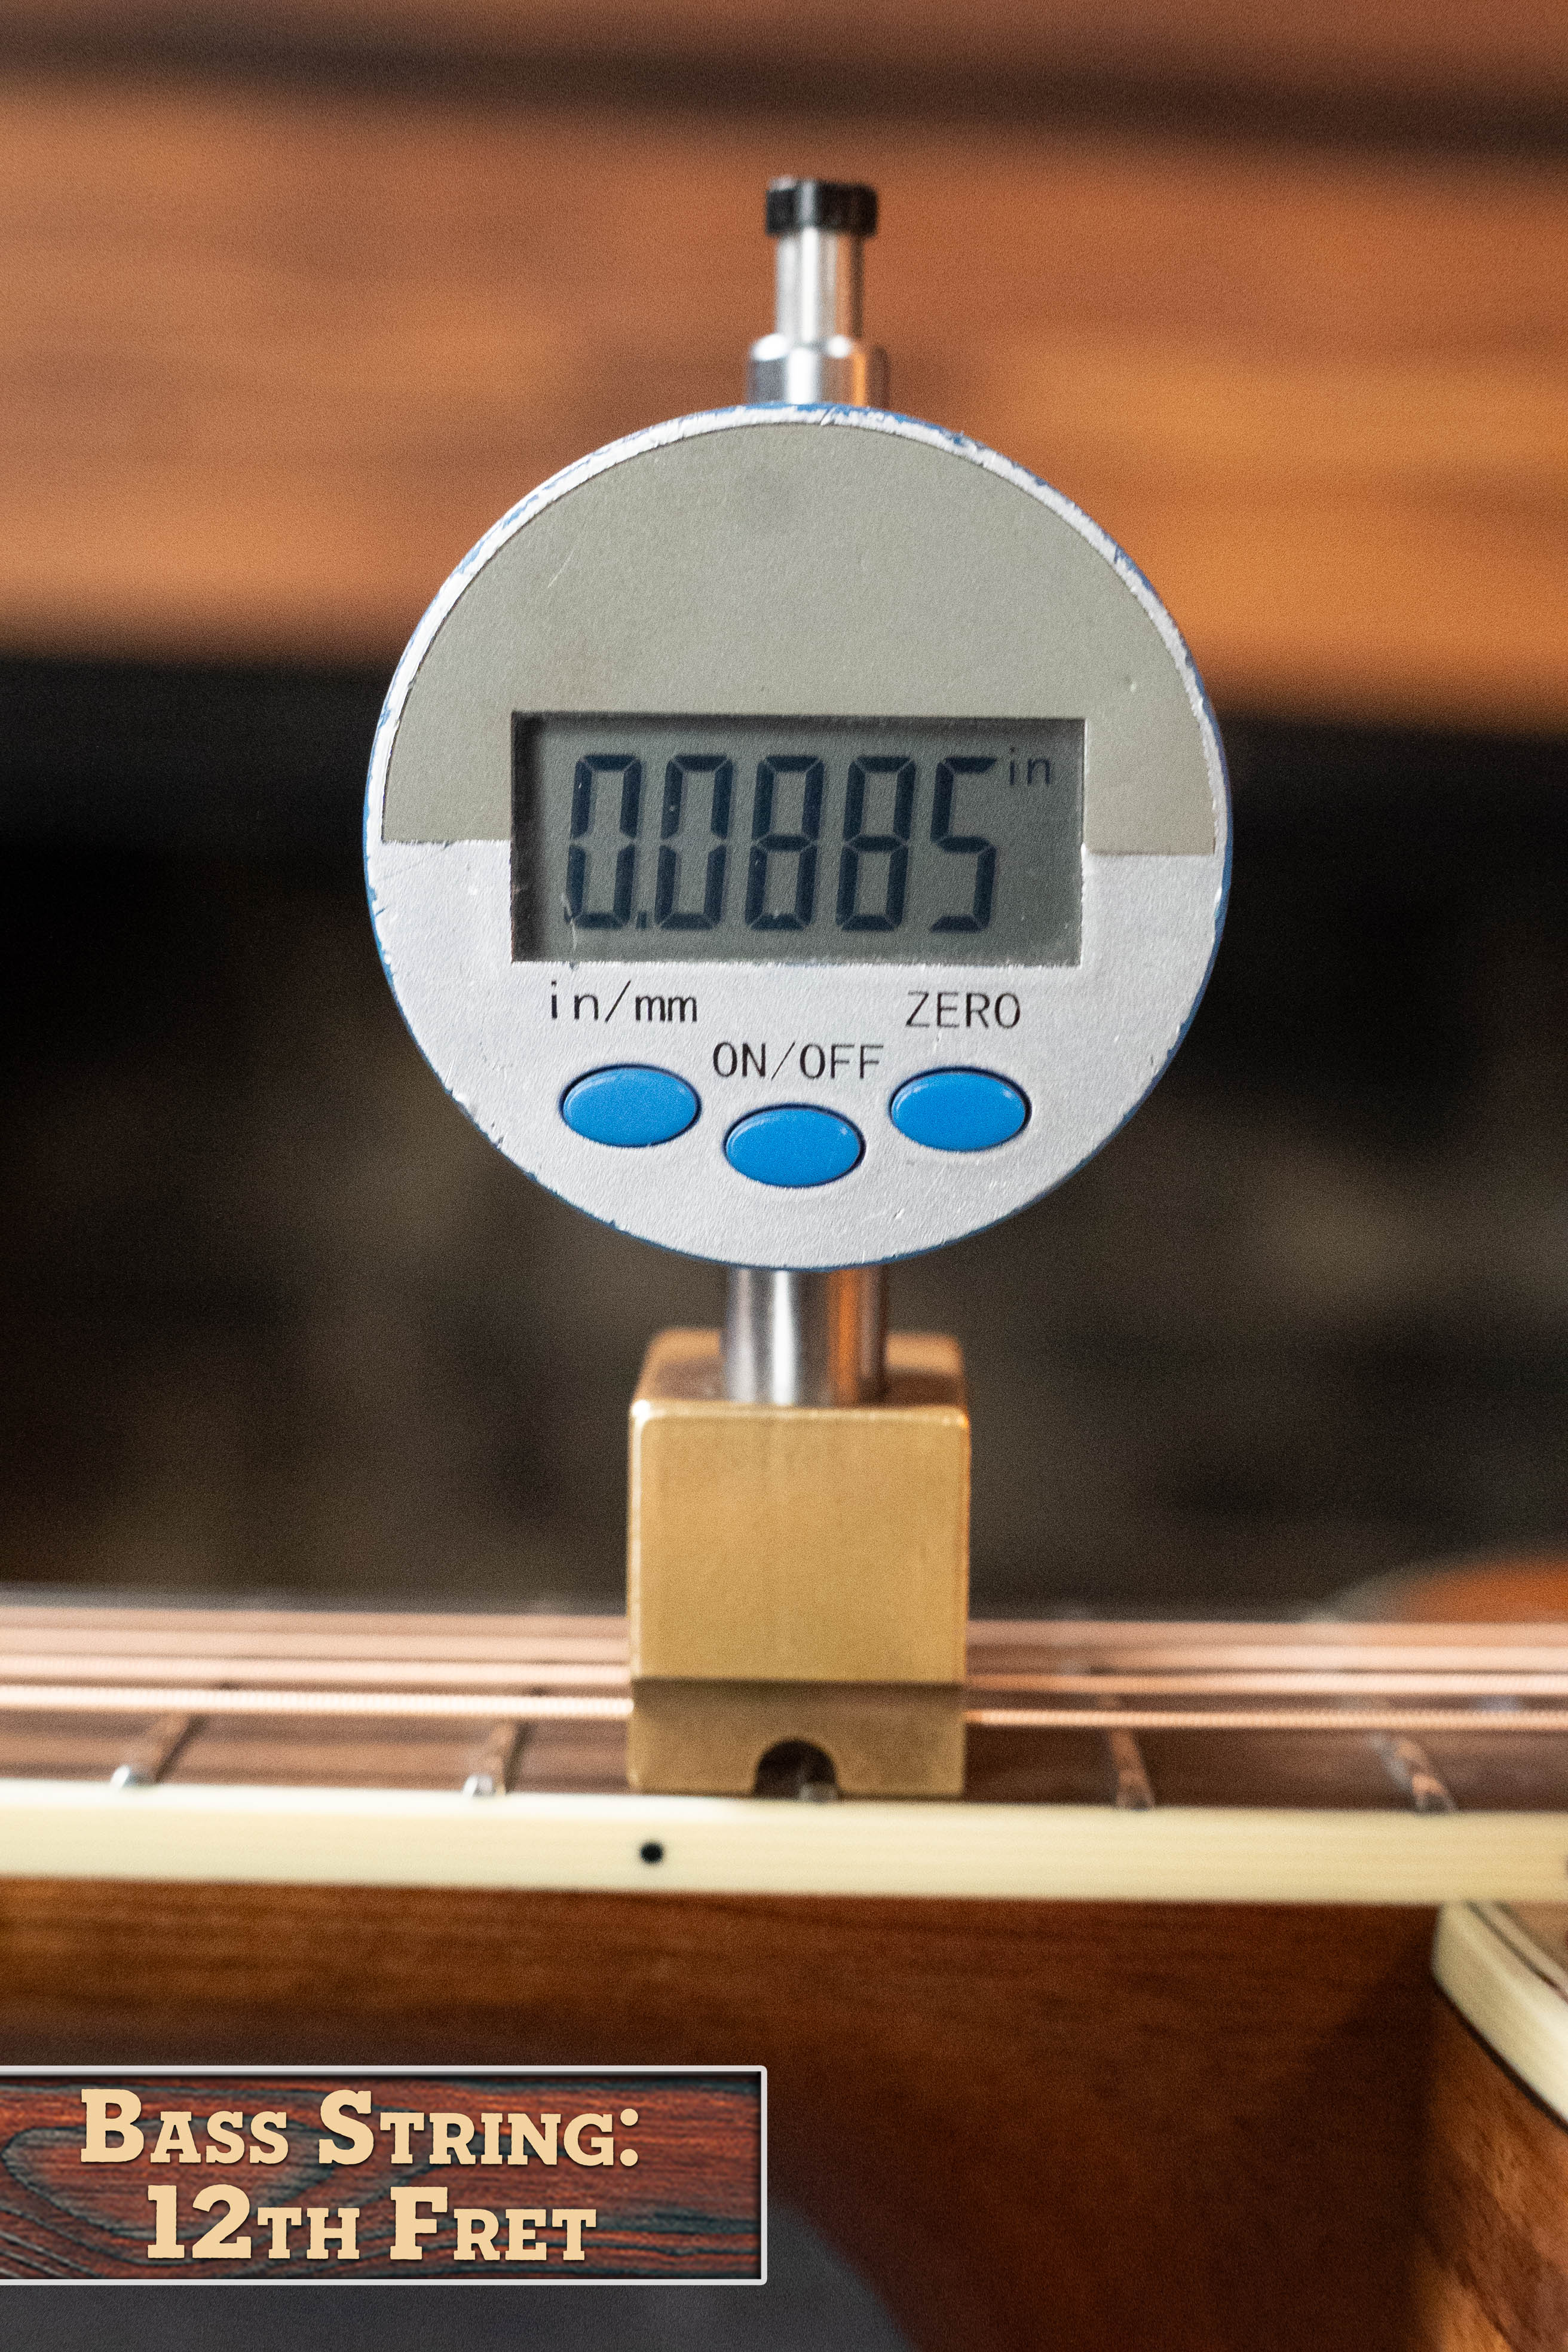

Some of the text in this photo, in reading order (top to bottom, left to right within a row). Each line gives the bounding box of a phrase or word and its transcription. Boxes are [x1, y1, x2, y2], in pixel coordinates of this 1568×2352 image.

[564, 748, 1054, 931] 0.0885 in
[551, 981, 698, 1022] in/mm
[905, 991, 1022, 1029] ZERO
[713, 1042, 884, 1080] ON/OFF
